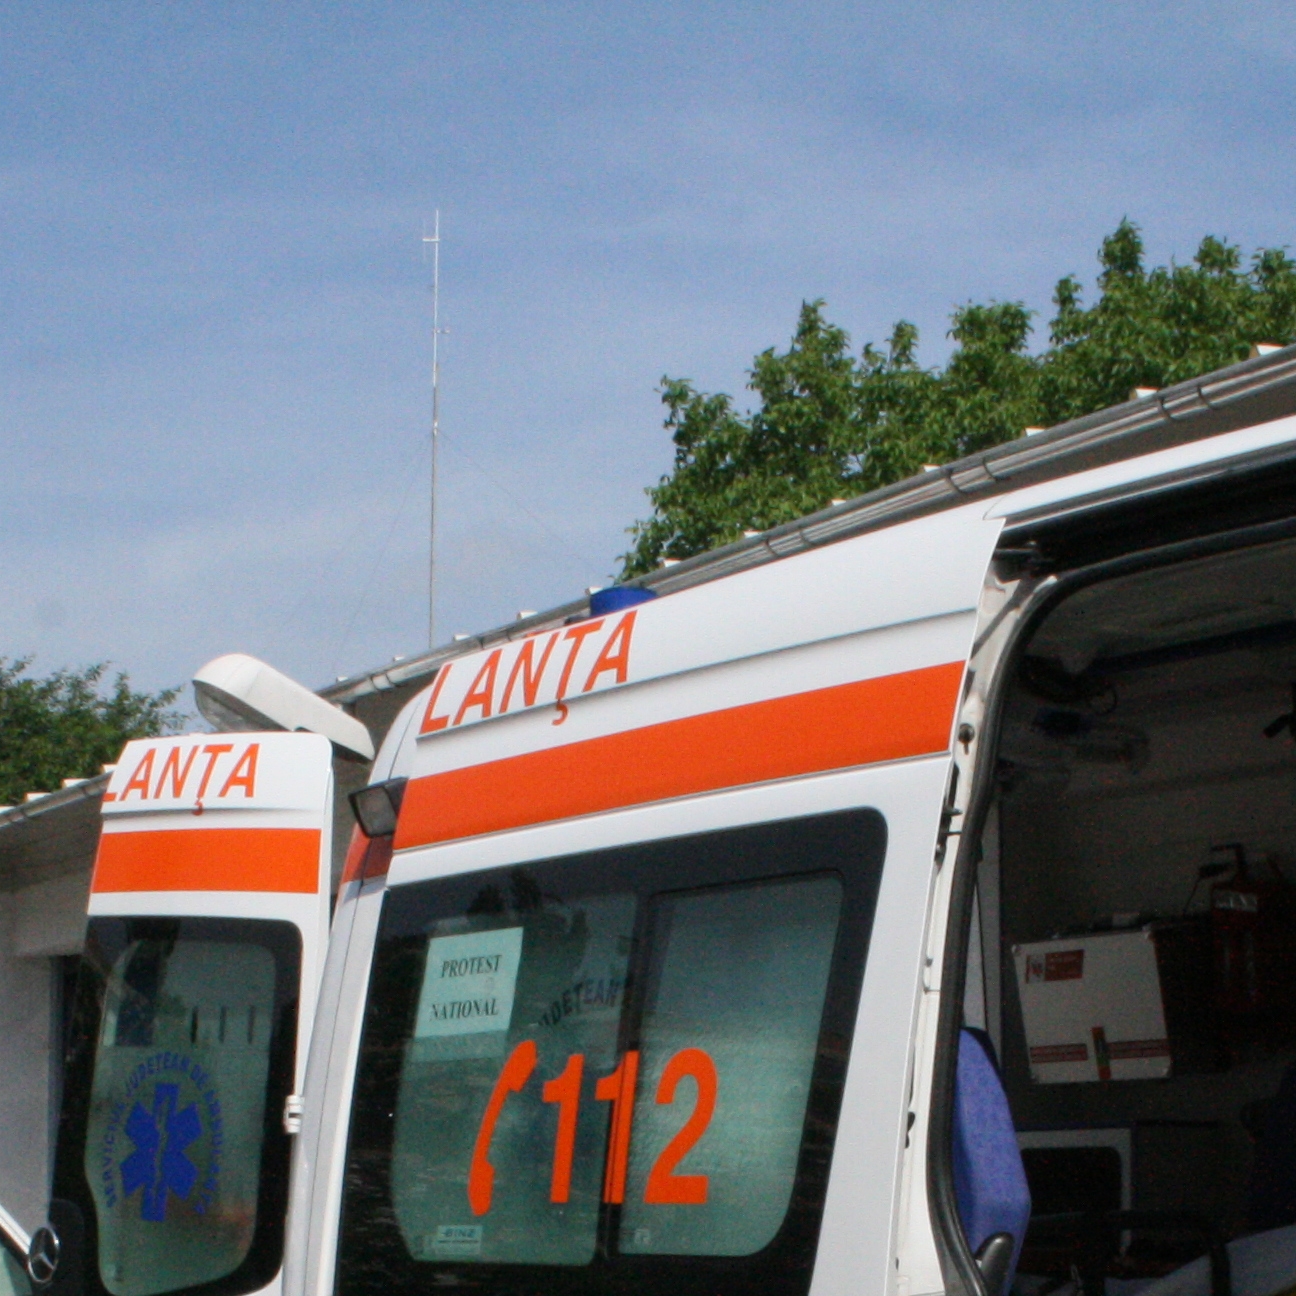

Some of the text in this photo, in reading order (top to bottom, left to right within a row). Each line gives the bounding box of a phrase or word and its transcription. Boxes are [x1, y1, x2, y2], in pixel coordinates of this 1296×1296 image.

[439, 954, 503, 979] PROTEST
[429, 998, 500, 1022] NATIONAL
[542, 1047, 718, 1204] 112
